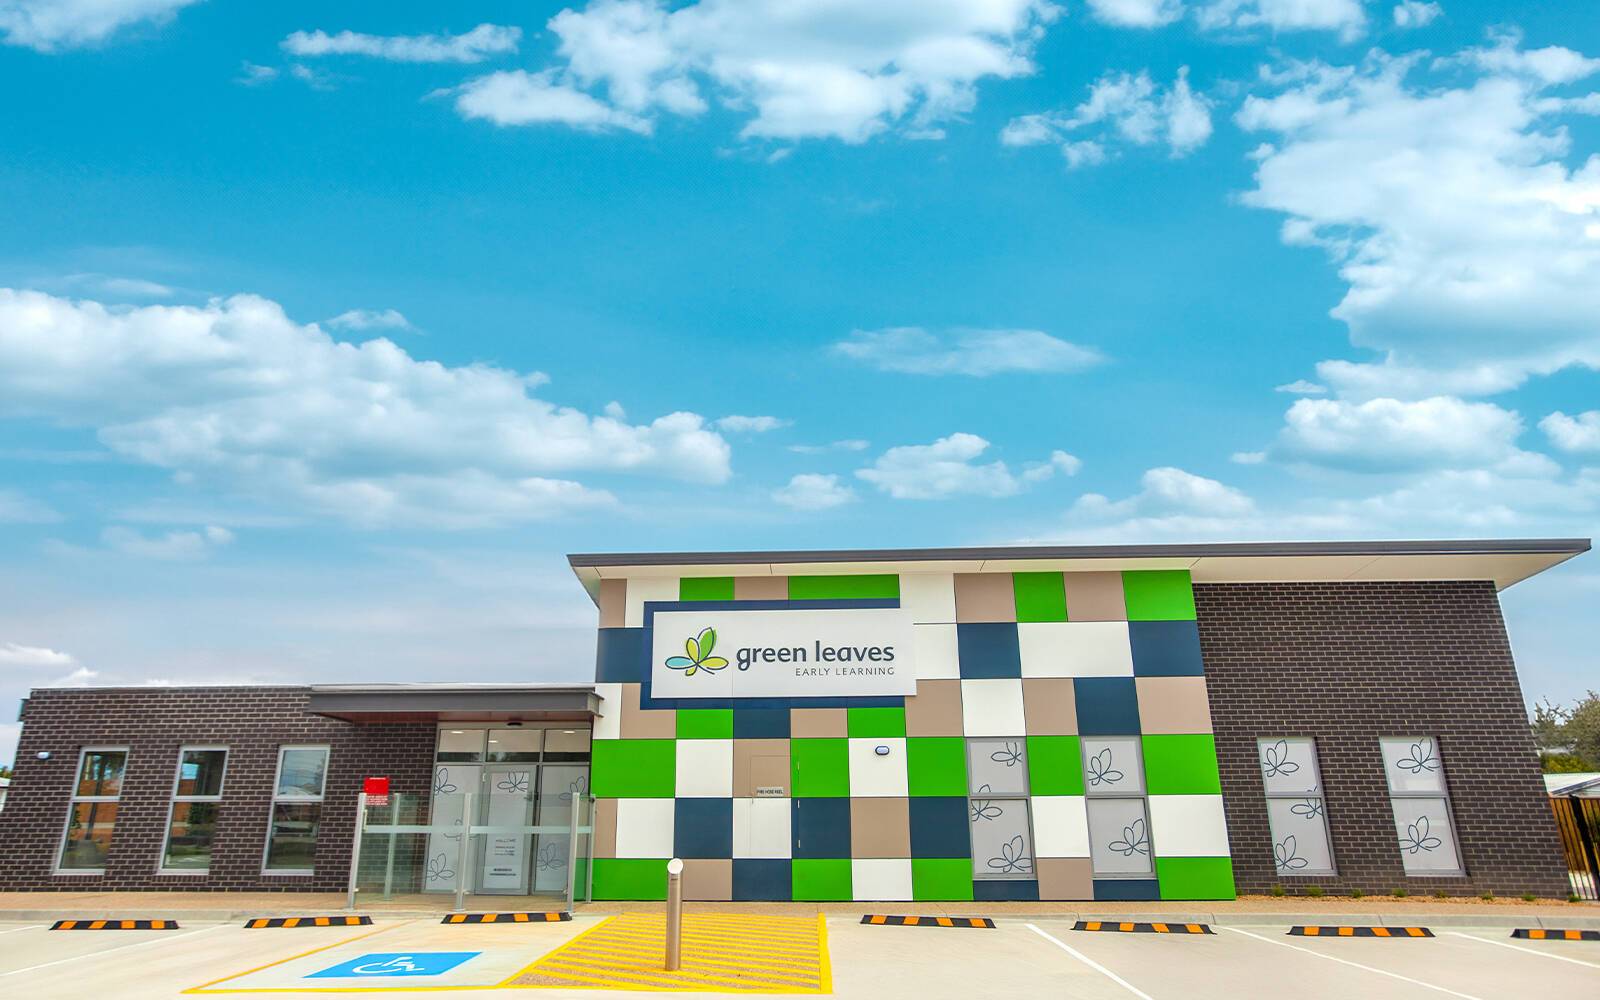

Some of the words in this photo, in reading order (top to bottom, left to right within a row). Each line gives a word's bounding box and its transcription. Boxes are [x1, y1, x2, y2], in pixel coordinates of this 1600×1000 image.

[736, 646, 807, 671] green
[815, 640, 895, 662] leaves
[795, 667, 830, 677] EARLY
[835, 666, 895, 676] LEARNING
